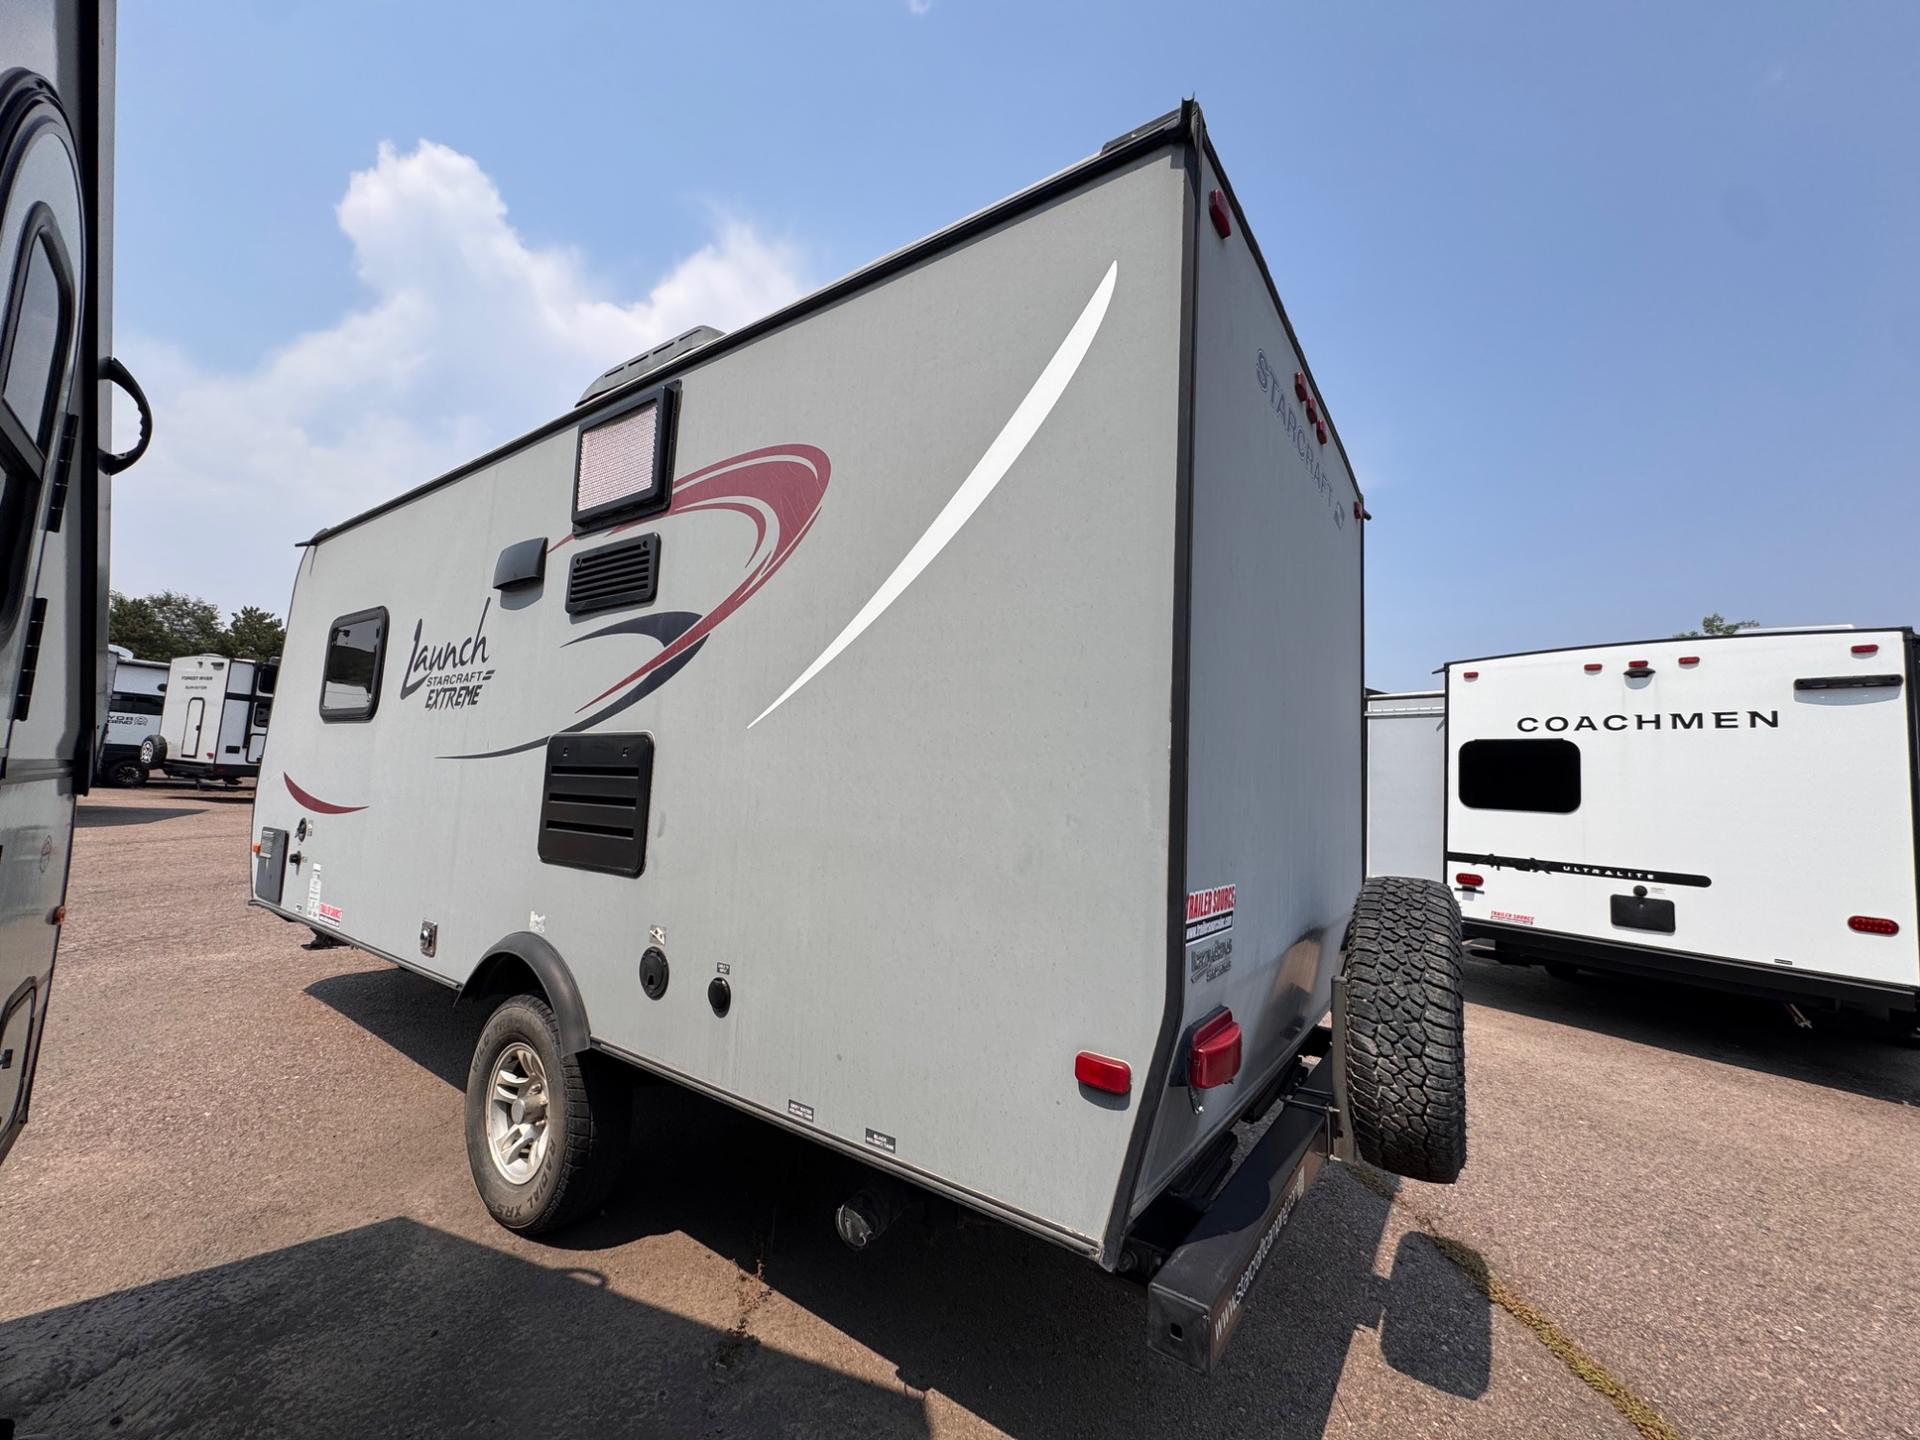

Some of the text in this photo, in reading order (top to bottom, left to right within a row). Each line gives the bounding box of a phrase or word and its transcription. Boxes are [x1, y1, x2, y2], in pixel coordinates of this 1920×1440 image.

[1257, 348, 1333, 507] STARCRAFT
[400, 597, 492, 700] Launch
[426, 671, 484, 687] STARCRAFT
[425, 685, 483, 711] EXTREME
[1516, 710, 1779, 733] COACHMEN
[1563, 865, 1655, 880] ULTRALITE
